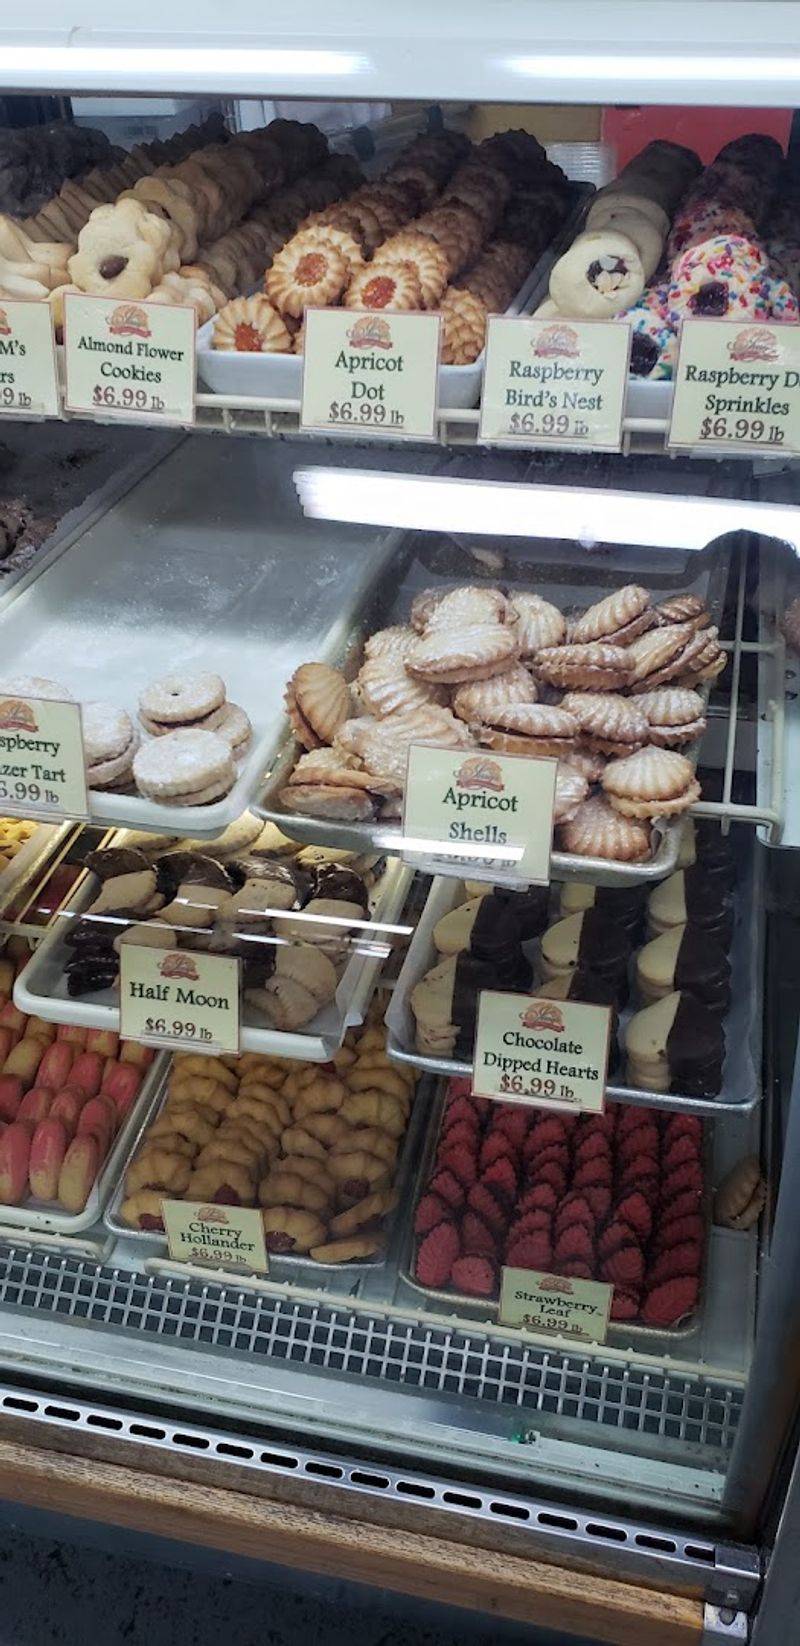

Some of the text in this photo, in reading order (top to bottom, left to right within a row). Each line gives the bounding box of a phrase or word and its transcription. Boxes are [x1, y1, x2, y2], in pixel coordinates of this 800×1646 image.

[77, 336, 184, 361] Almond Flower
[100, 362, 162, 383] Cookies
[335, 350, 404, 374] Apricot
[509, 360, 604, 387] Raspberry
[685, 365, 800, 391] Raspberry D
[0, 387, 32, 407] 9 lb
[93, 384, 165, 409] $6.99 lb
[351, 381, 385, 400] Dot
[506, 388, 603, 411] Bird's Nest
[329, 401, 405, 425] $6.99 lb
[705, 394, 790, 416] Sprinkles
[509, 412, 589, 435] $6.99 lb
[701, 417, 785, 441] $6.99 lb
[0, 764, 66, 783] zer Tart
[45, 789, 60, 804] lb
[442, 787, 519, 812] Apricot
[449, 821, 507, 844] Shells
[130, 981, 229, 1010] Half Moon
[145, 1017, 213, 1040] $6.99 lb
[502, 1031, 583, 1055] Chocolate
[483, 1051, 599, 1081] Dipped Hearts
[500, 1073, 556, 1096] $6.99
[180, 1231, 256, 1252] Hollander
[189, 1222, 242, 1238] Cherry
[191, 1247, 233, 1261] $6.99
[514, 1290, 598, 1315] Strawberry
[540, 1304, 572, 1318] Leaf
[522, 1313, 568, 1330] $6.99
